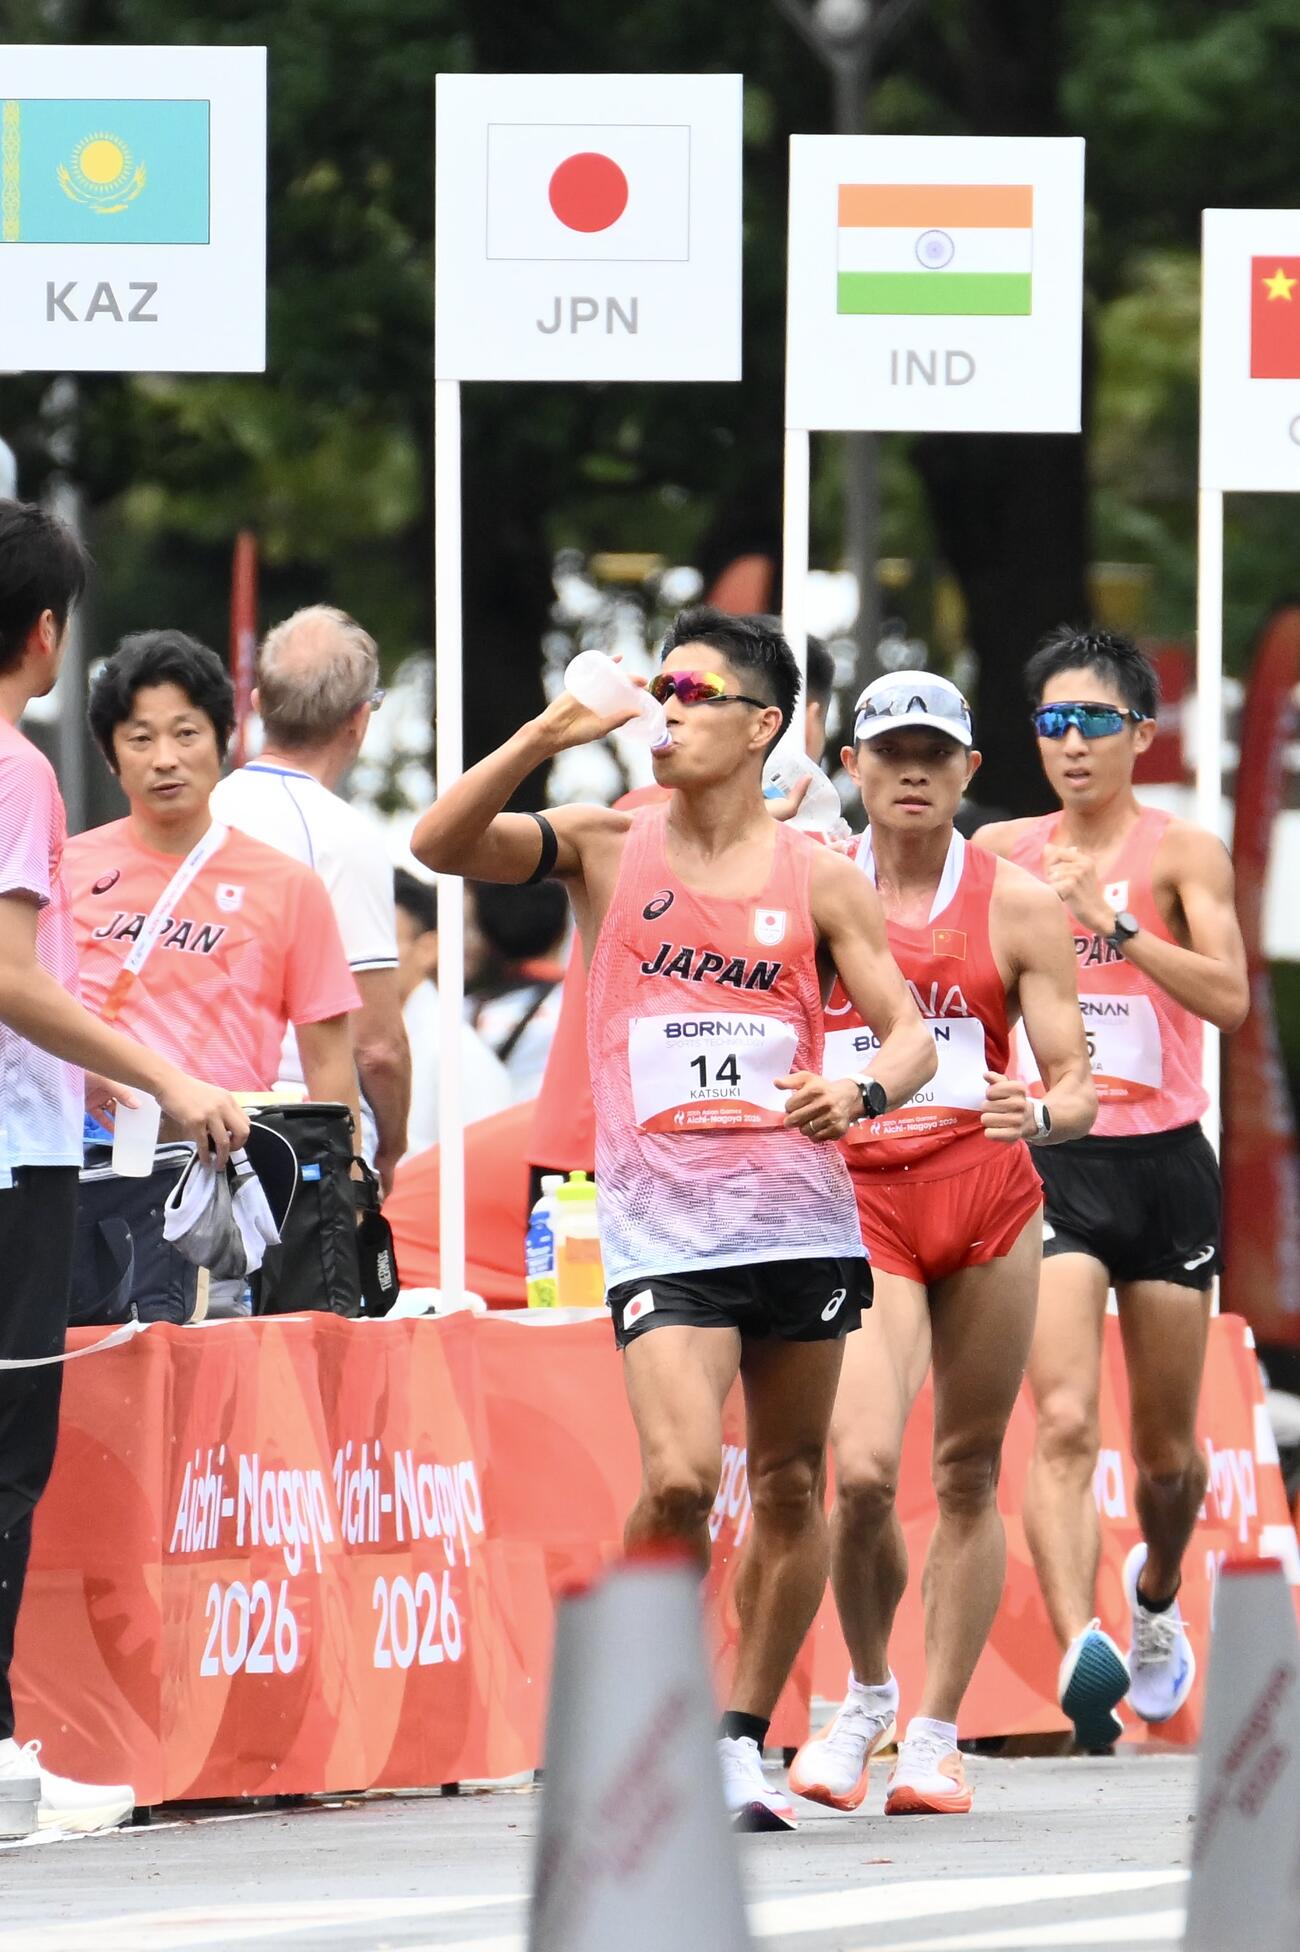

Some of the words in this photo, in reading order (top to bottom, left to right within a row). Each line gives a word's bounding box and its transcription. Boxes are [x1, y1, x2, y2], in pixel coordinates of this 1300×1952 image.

[46, 281, 158, 322] KAZ
[536, 296, 638, 334] JPN
[890, 349, 977, 385] IND
[641, 943, 783, 992] JAPAN
[1078, 1001, 1130, 1016] RNAN
[664, 1021, 766, 1039] BORNAN
[690, 1053, 741, 1088] 14
[690, 1087, 741, 1099] KATSUKI
[200, 1579, 298, 1677] 2026
[373, 1569, 461, 1669] 2026
